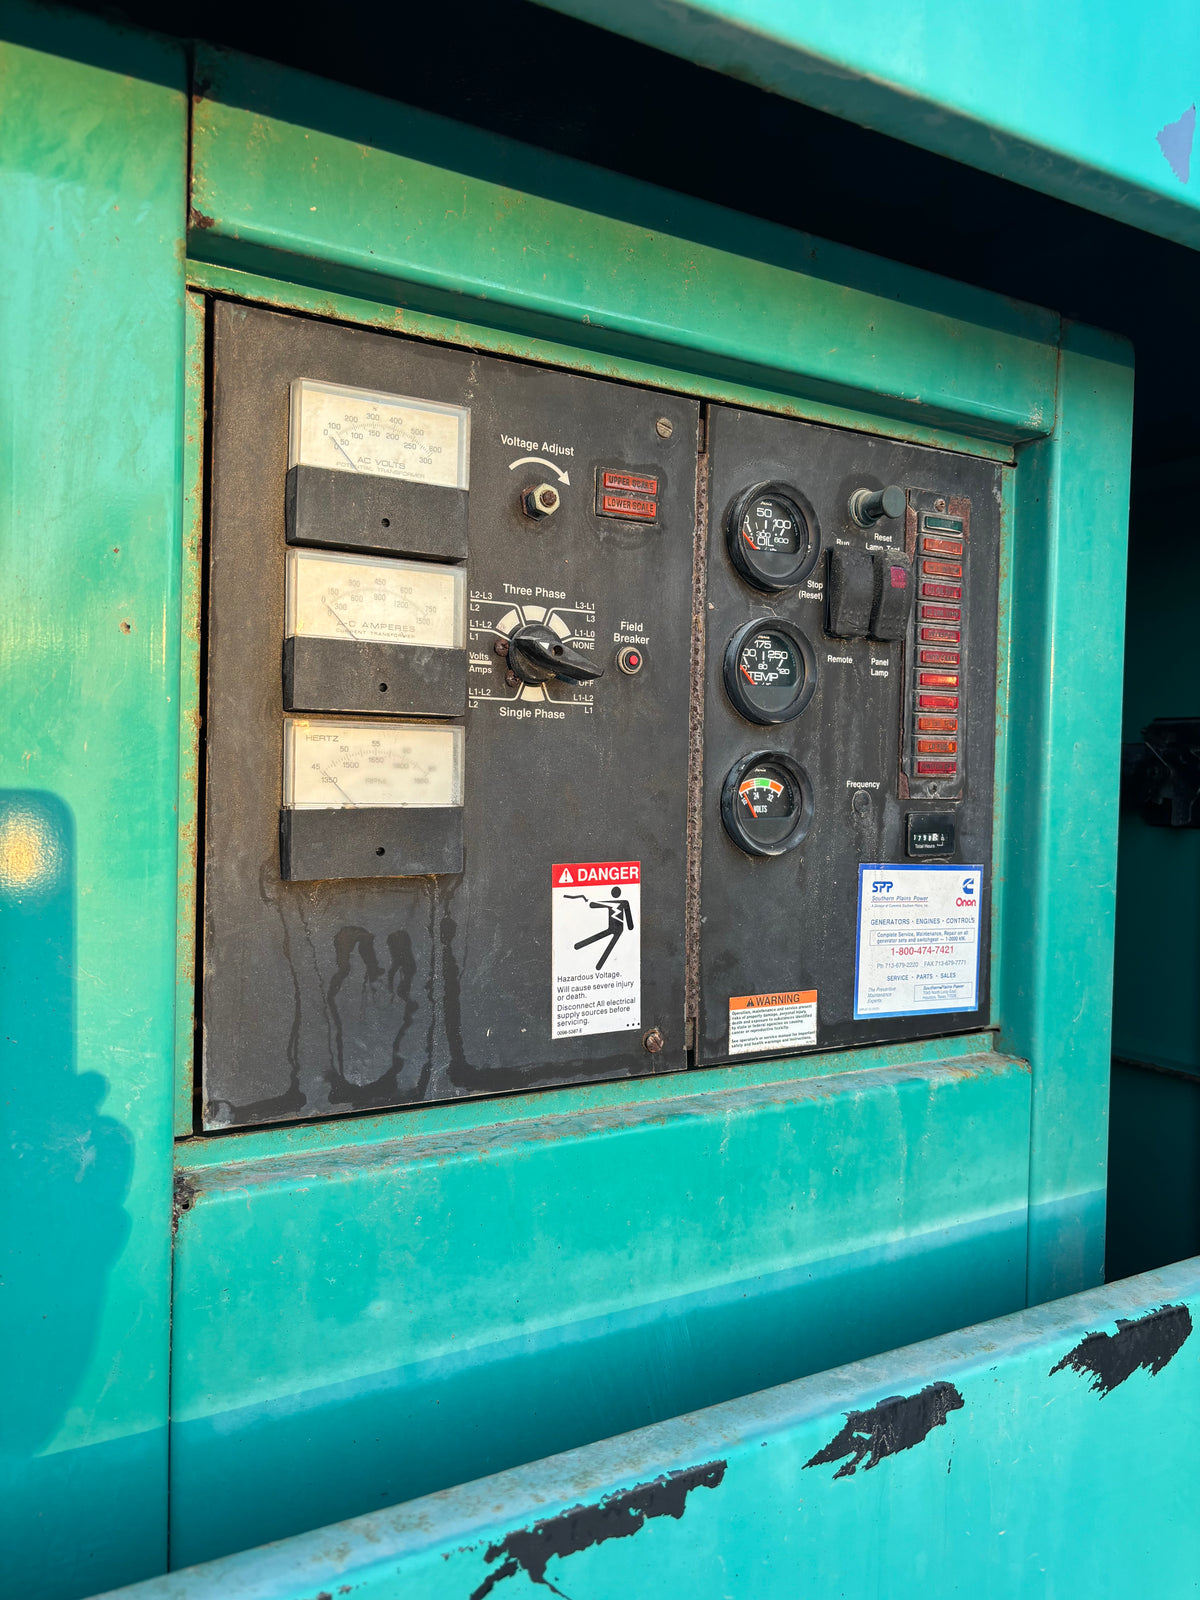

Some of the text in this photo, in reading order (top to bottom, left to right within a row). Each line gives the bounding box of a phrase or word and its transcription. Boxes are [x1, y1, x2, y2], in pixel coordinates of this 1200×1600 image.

[501, 434, 574, 456] Voltage Adjust
[375, 459, 406, 470] VOLTS
[608, 476, 654, 490] UPPER SCALE
[607, 498, 654, 512] LOWER SCALE
[757, 508, 772, 518] 50
[757, 536, 774, 547] OIL
[874, 533, 892, 542] Reset
[807, 580, 823, 590] Stop
[470, 591, 492, 599] L2-L3
[503, 583, 566, 600] Three Phase
[798, 591, 823, 601] (Reset)
[575, 602, 595, 610] L3-L1
[362, 622, 415, 633] AMPERES
[470, 620, 492, 628] L1-L2
[620, 621, 643, 632] Field
[614, 633, 650, 645] Breaker
[572, 641, 595, 650] NONE
[754, 640, 772, 649] 175
[469, 652, 489, 660] Volts
[768, 650, 788, 659] 250
[827, 655, 853, 664] Remote
[871, 658, 889, 666] Panel
[469, 665, 492, 674] Amps
[871, 669, 889, 678] Lamp
[748, 671, 778, 681] TEMP
[468, 688, 491, 696] L1-L2
[500, 707, 565, 720] Single Phase
[846, 780, 880, 789] Frequency
[753, 792, 759, 800] 24
[578, 866, 638, 882] DANGER
[872, 881, 893, 893] SPP
[891, 946, 954, 956] 1-800-474-7421
[557, 974, 594, 983] Hazardous
[616, 980, 634, 989] injury
[566, 992, 587, 1000] death.
[756, 993, 800, 1006] WARNING
[557, 1001, 595, 1011] Disconnect
[606, 997, 636, 1006] electrical
[557, 1005, 630, 1019] supply sources before
[557, 1018, 590, 1027] servicing.
